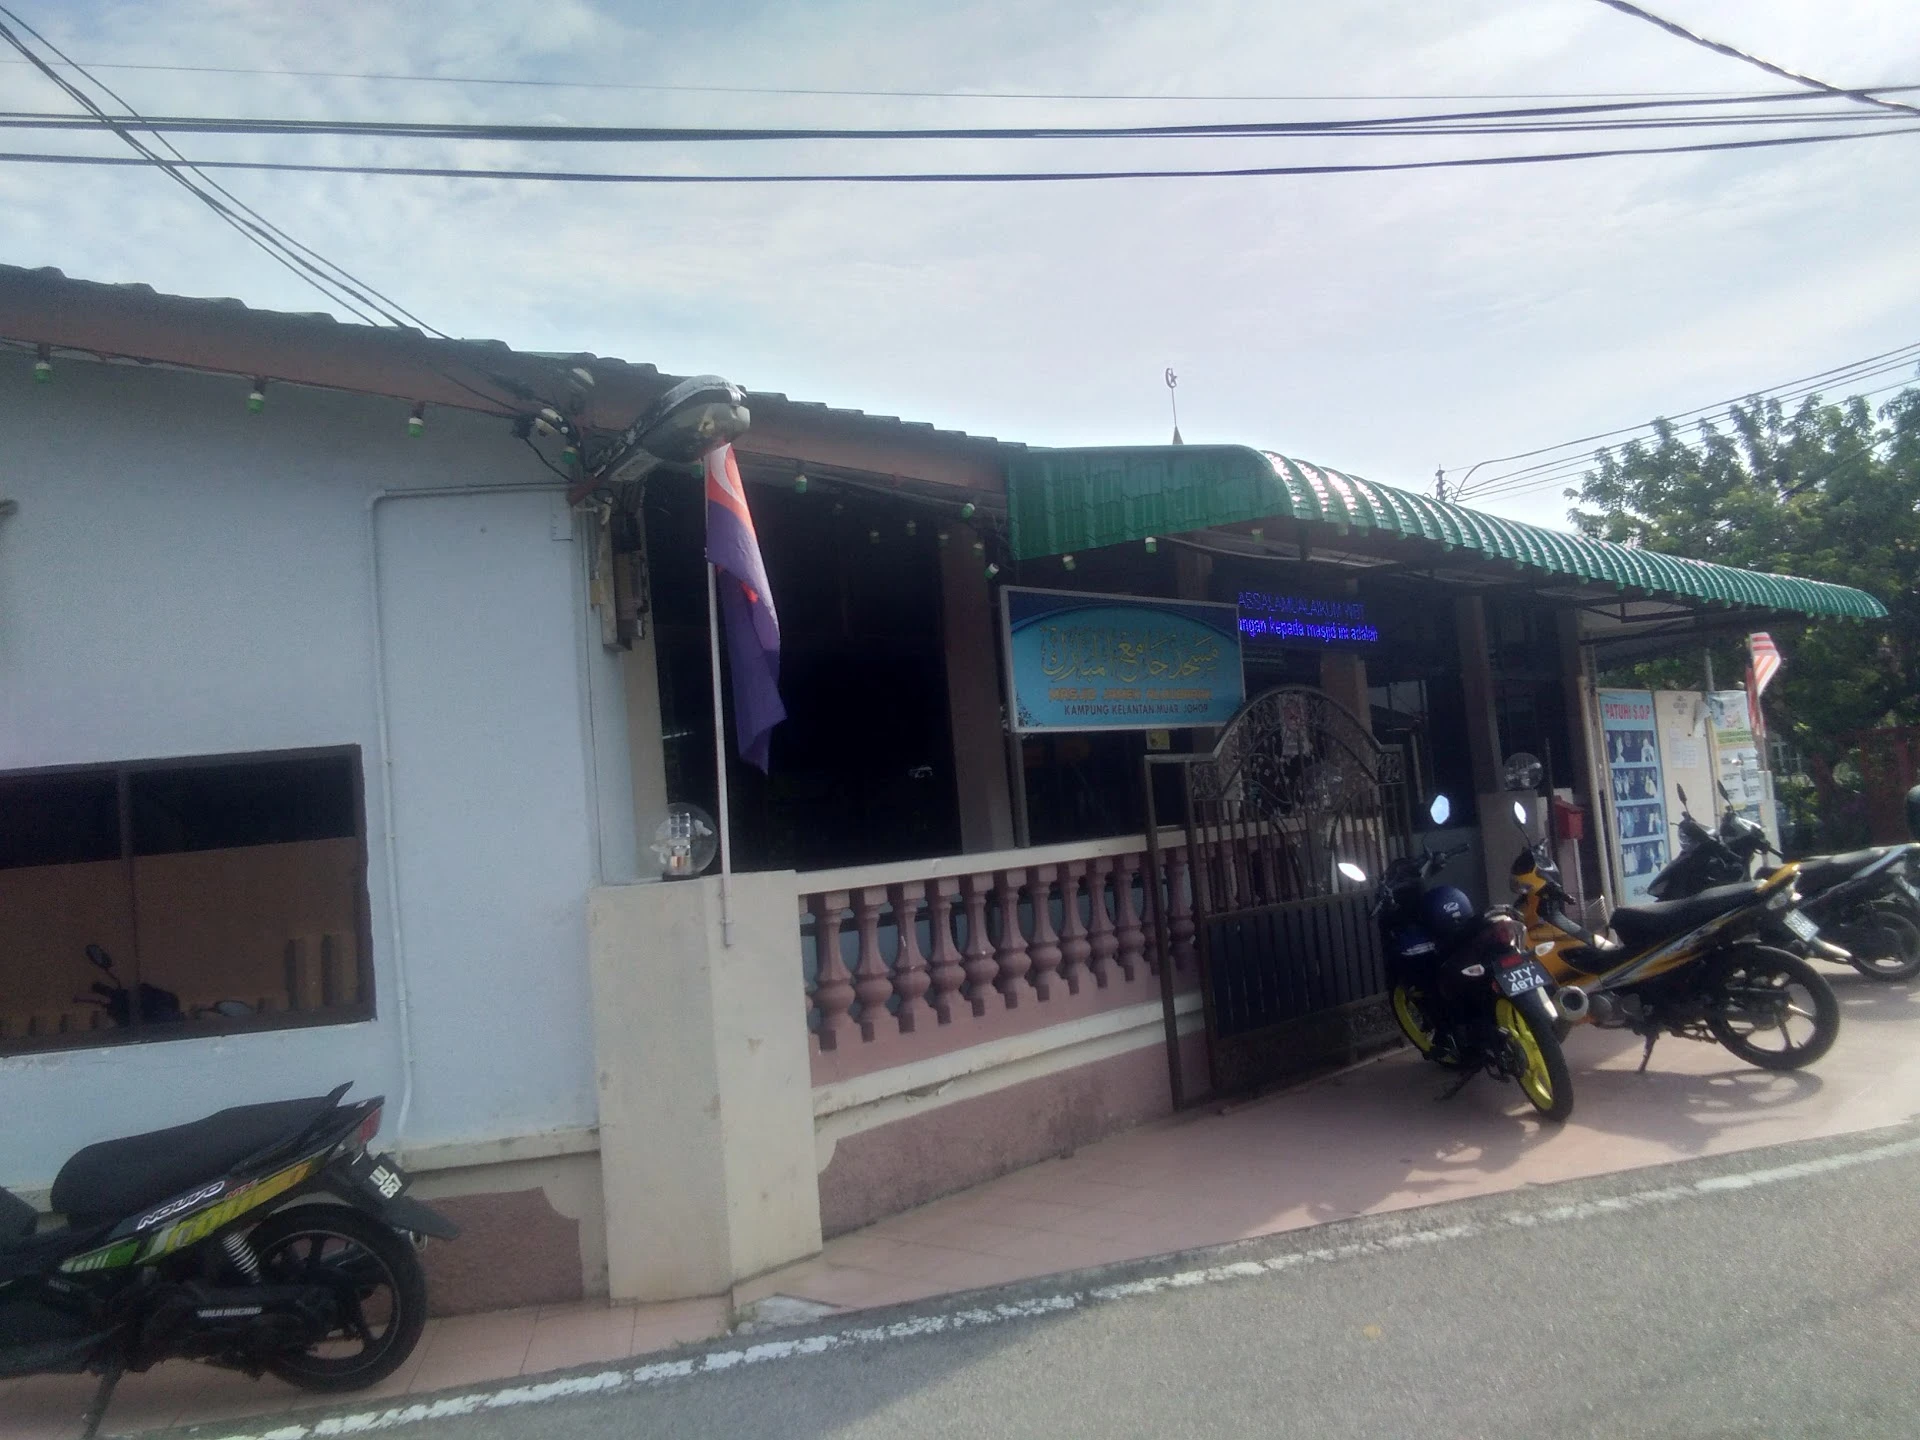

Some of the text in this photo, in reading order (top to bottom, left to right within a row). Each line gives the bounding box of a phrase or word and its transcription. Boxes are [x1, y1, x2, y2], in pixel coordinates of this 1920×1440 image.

[1268, 616, 1304, 639] kepada
[1306, 622, 1337, 642] masjid
[1351, 625, 1378, 641] adalah
[1064, 704, 1110, 716] KAMPUNG
[1183, 703, 1209, 714] JOHOR
[1604, 703, 1630, 720] PATUHI
[1507, 965, 1532, 983] JTY
[1511, 974, 1545, 992] 4874
[136, 1180, 226, 1231] NOUVO
